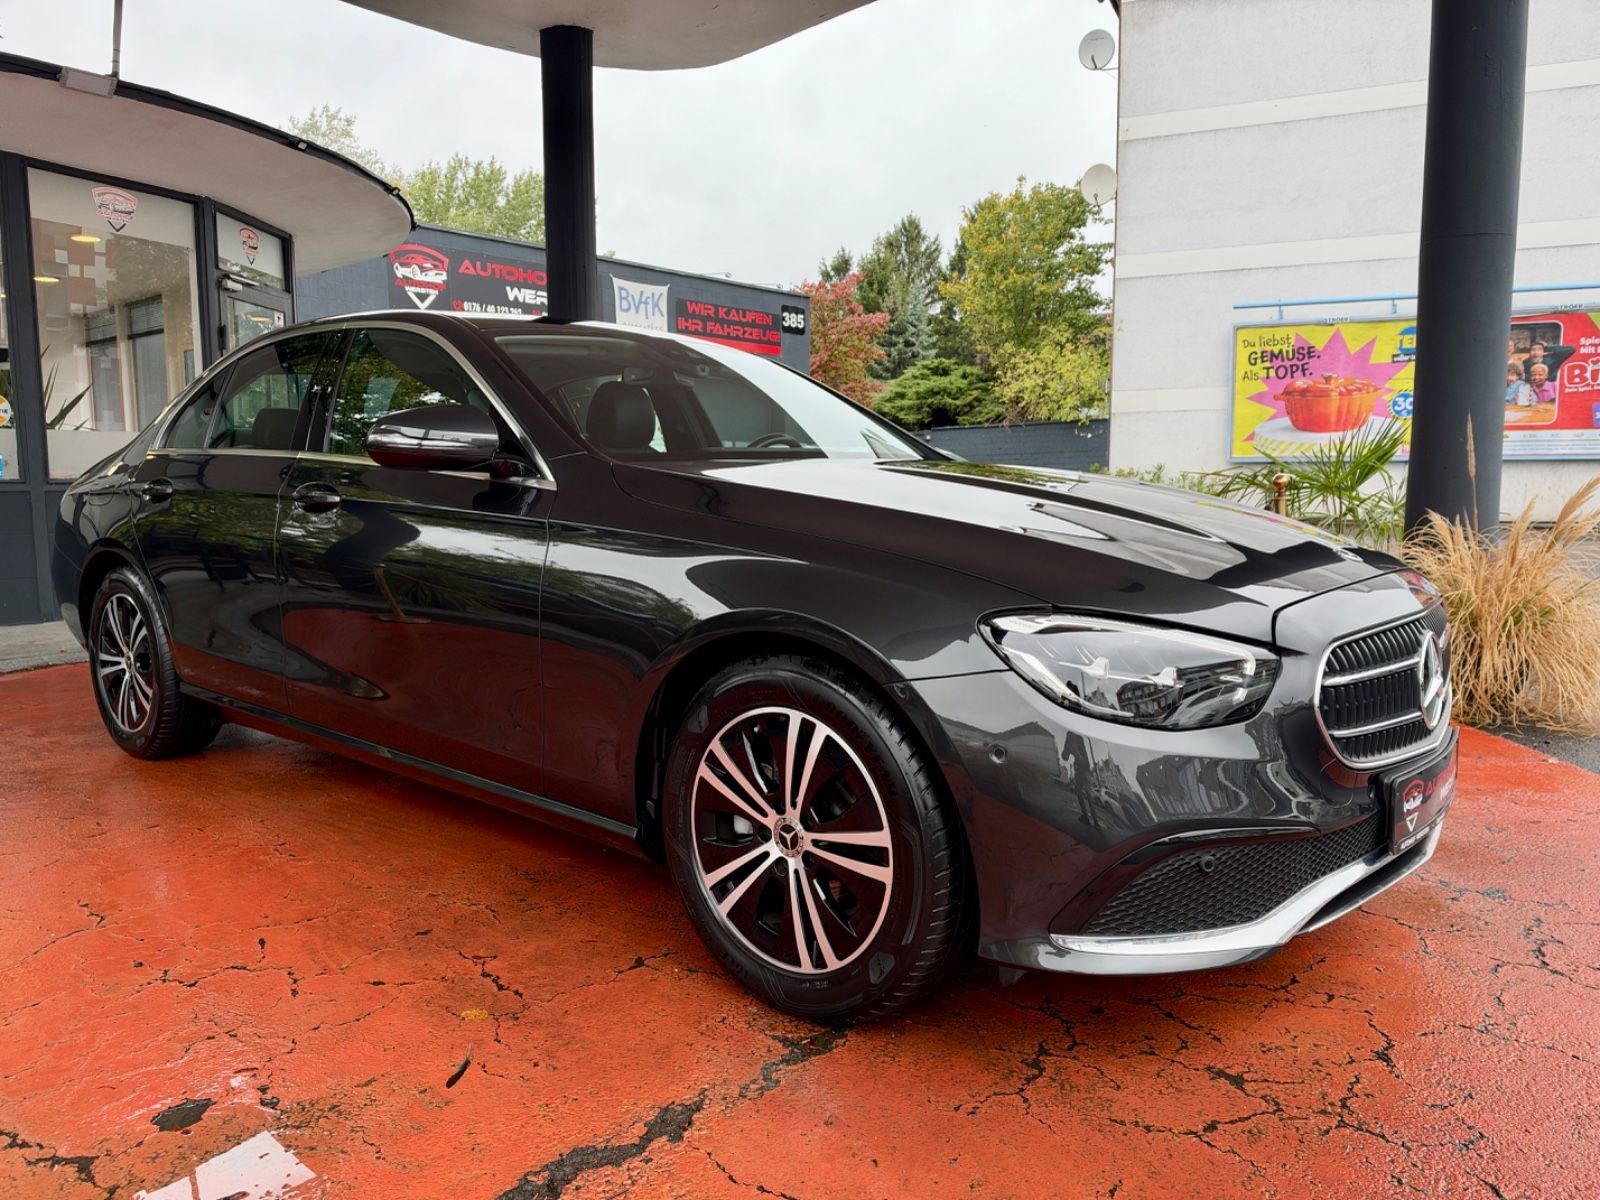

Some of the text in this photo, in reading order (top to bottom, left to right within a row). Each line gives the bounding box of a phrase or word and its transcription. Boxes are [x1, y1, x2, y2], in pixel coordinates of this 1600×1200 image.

[617, 285, 665, 320] BVfK
[686, 301, 772, 325] WIR KAUFEN
[677, 317, 704, 332] IHR
[782, 312, 805, 329] 385
[1242, 333, 1293, 349] Du liebst
[1247, 344, 1321, 366] GEMÜSE.
[1242, 361, 1314, 382] Als TOPF.
